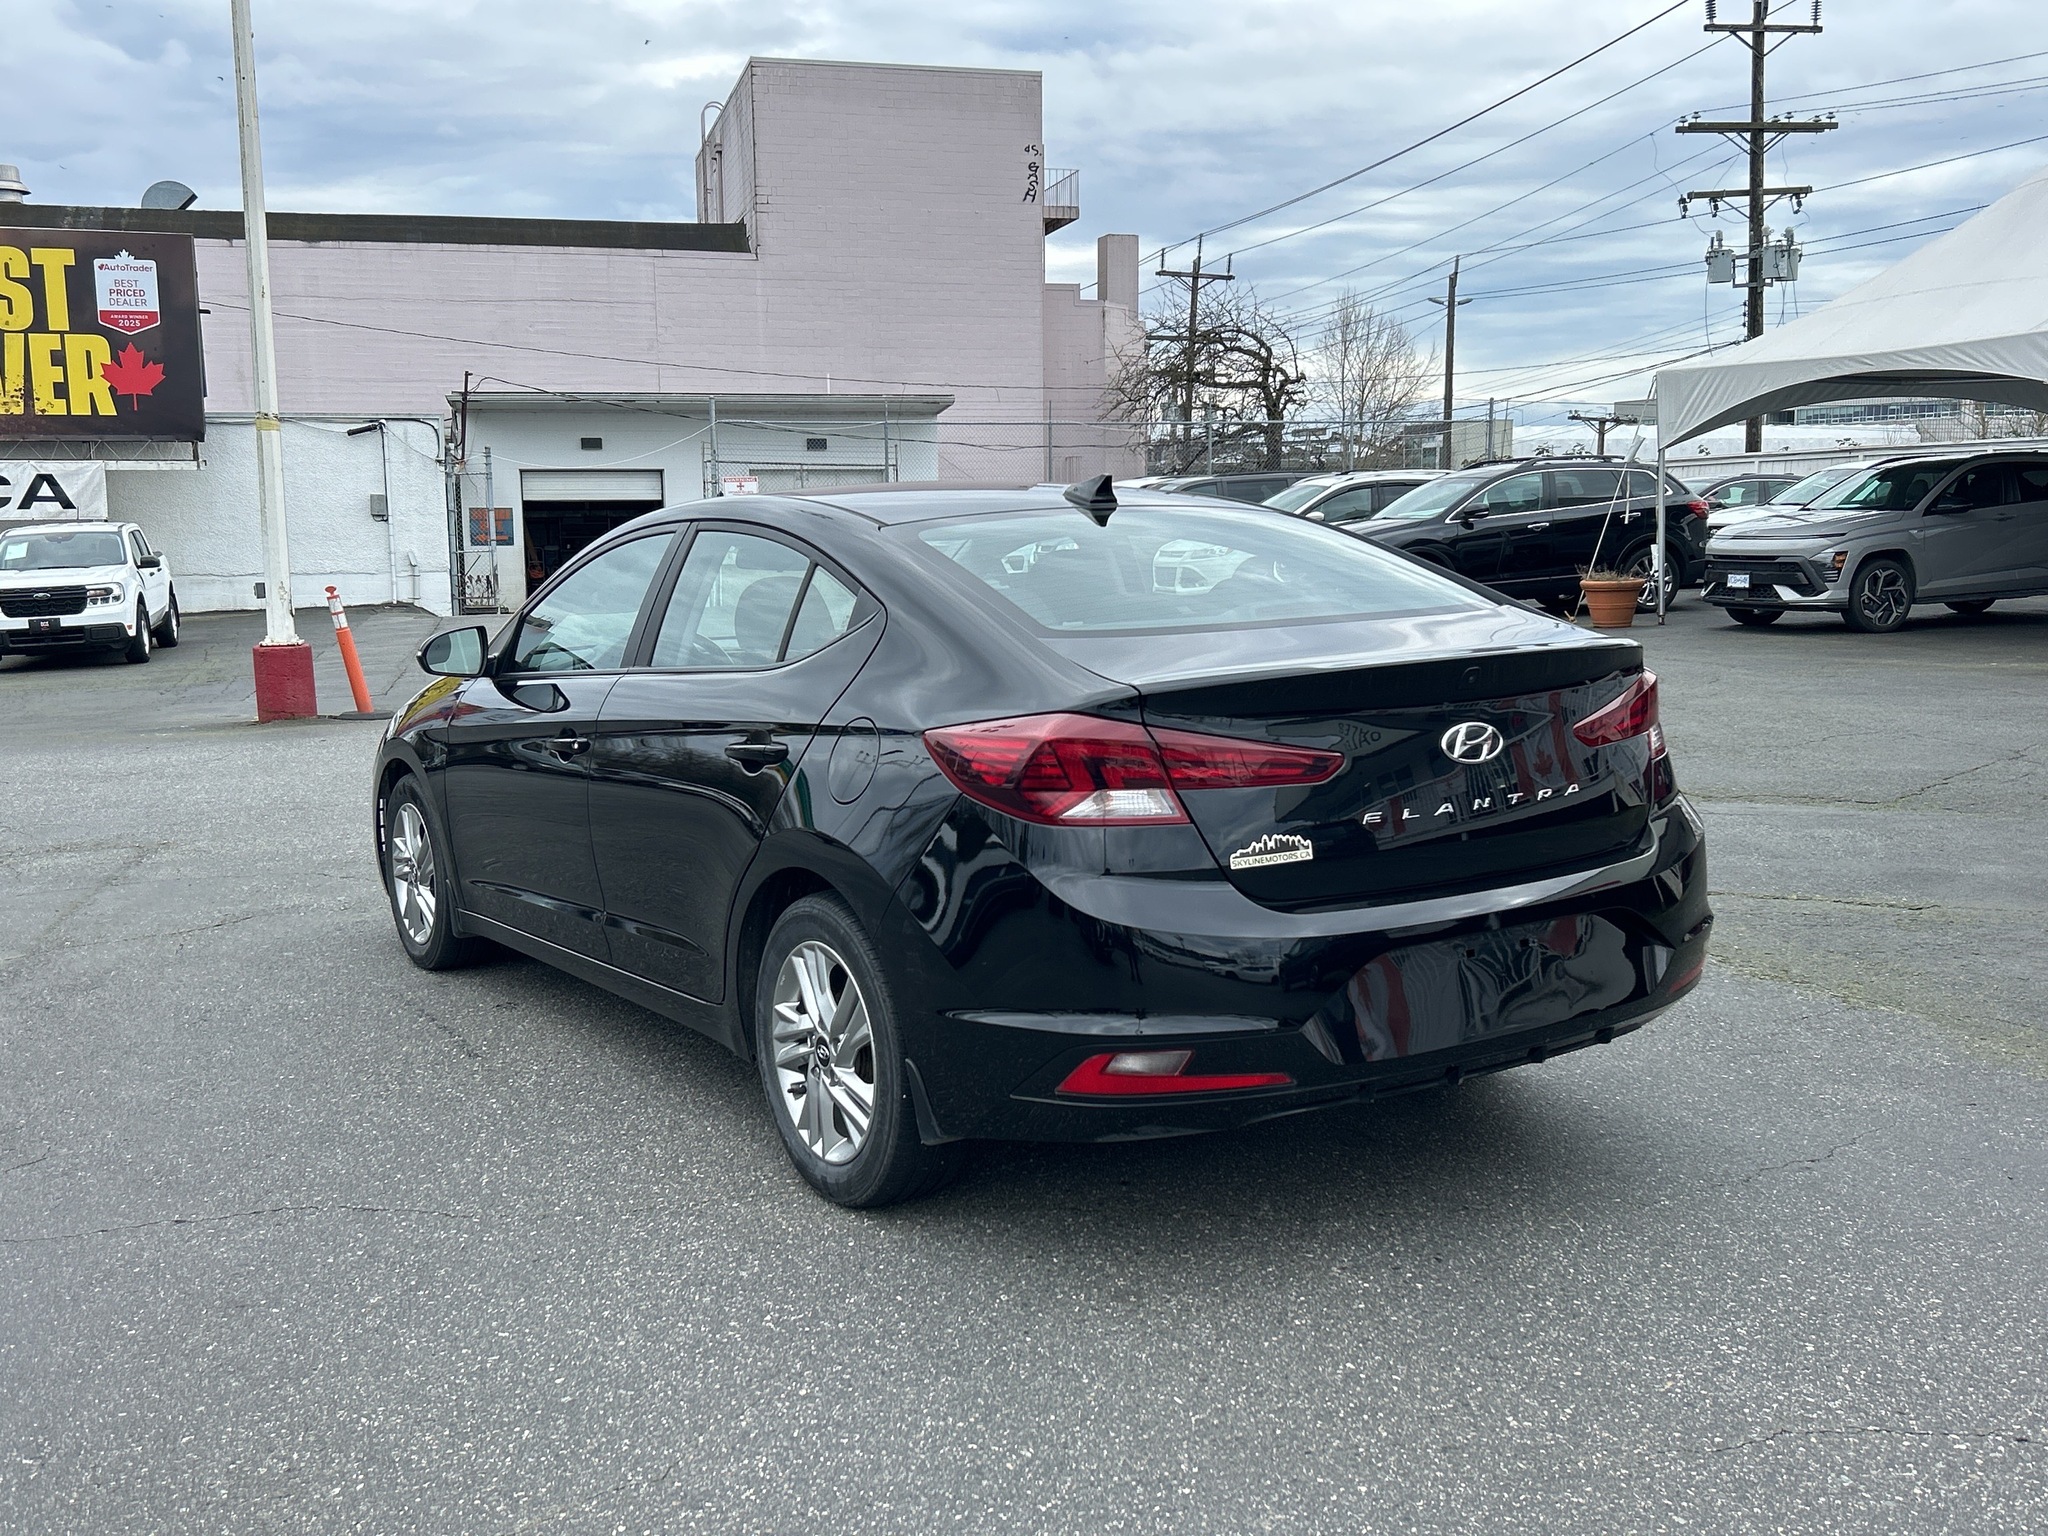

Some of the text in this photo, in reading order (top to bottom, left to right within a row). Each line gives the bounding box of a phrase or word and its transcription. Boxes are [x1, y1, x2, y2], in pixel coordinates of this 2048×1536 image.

[103, 263, 153, 272] AutoTrader
[114, 279, 139, 288] BEST
[109, 289, 146, 297] PRICED
[109, 298, 147, 307] DEALER
[1362, 783, 1580, 825] ELANTRA
[1231, 851, 1311, 868] SKYLINEMOTORS.CA
